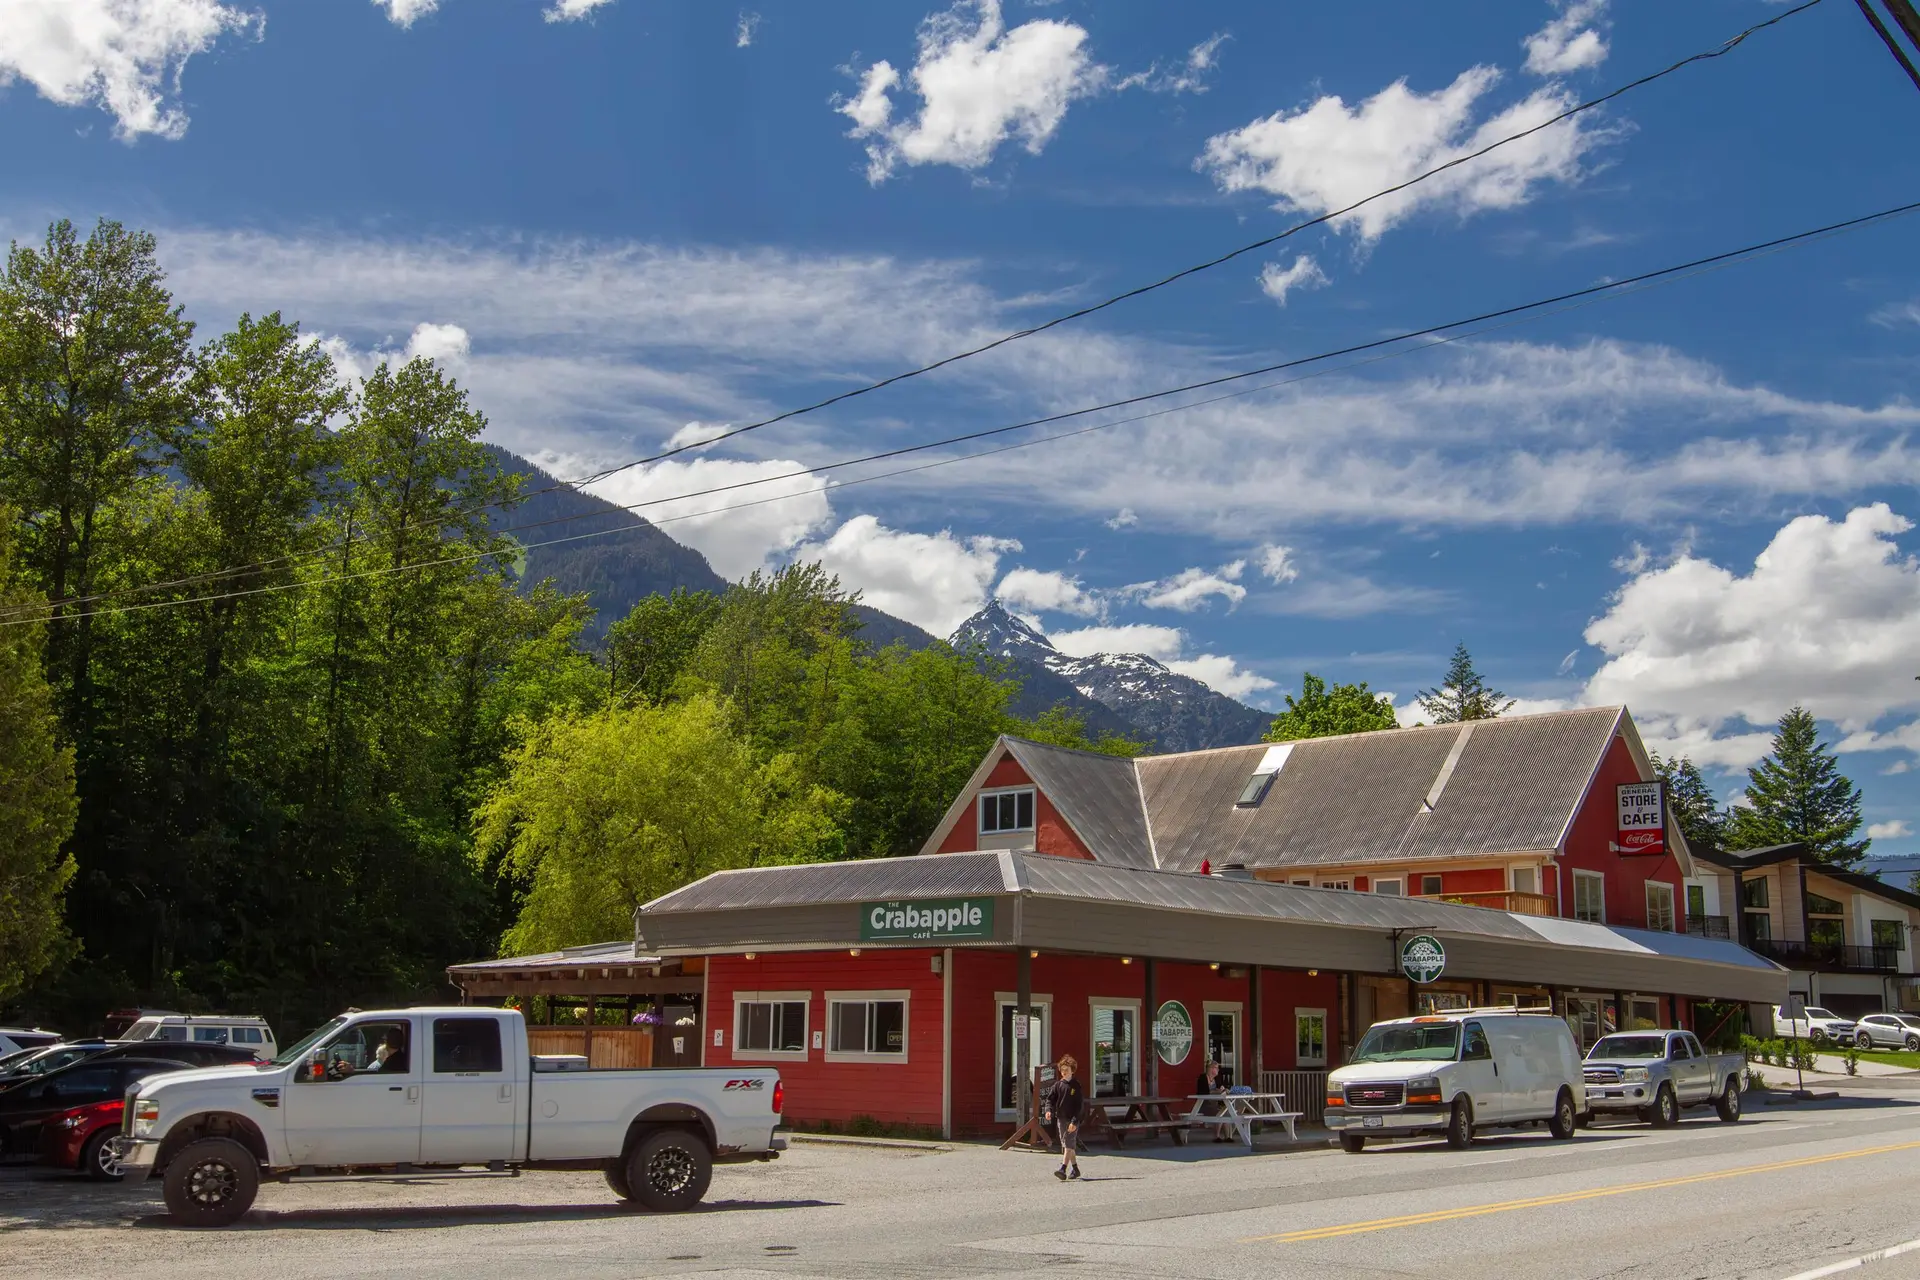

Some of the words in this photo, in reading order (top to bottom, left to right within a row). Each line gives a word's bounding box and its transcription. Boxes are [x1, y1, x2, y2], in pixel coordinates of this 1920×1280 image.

[1621, 794, 1657, 807] STORE
[1622, 813, 1658, 825] CAFE
[870, 902, 982, 931] Crabapple
[1159, 1028, 1192, 1037] RABAPPLE
[724, 1079, 765, 1088] FX4
